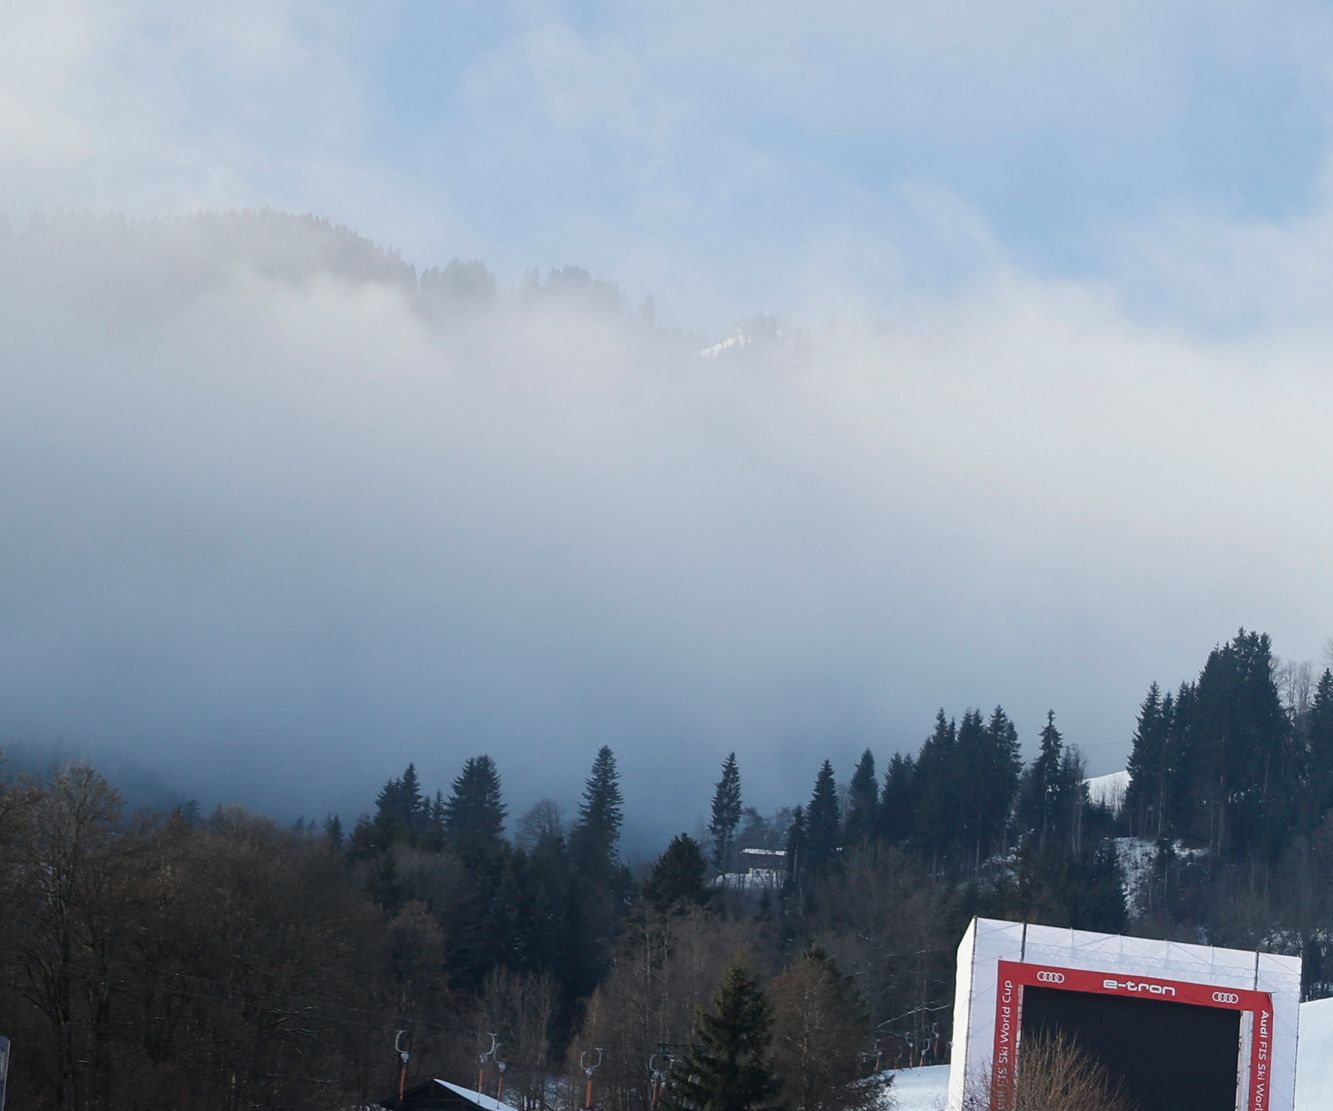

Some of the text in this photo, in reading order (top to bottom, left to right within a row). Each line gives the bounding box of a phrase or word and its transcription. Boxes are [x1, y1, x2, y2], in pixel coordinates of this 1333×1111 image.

[1002, 980, 1013, 1004] Cup
[1103, 979, 1175, 996] e-tron
[1000, 1006, 1011, 1043] World
[1260, 1010, 1270, 1038] Audi
[998, 1046, 1008, 1064] Ski
[1258, 1041, 1268, 1060] FIS
[1257, 1063, 1266, 1081] Ski
